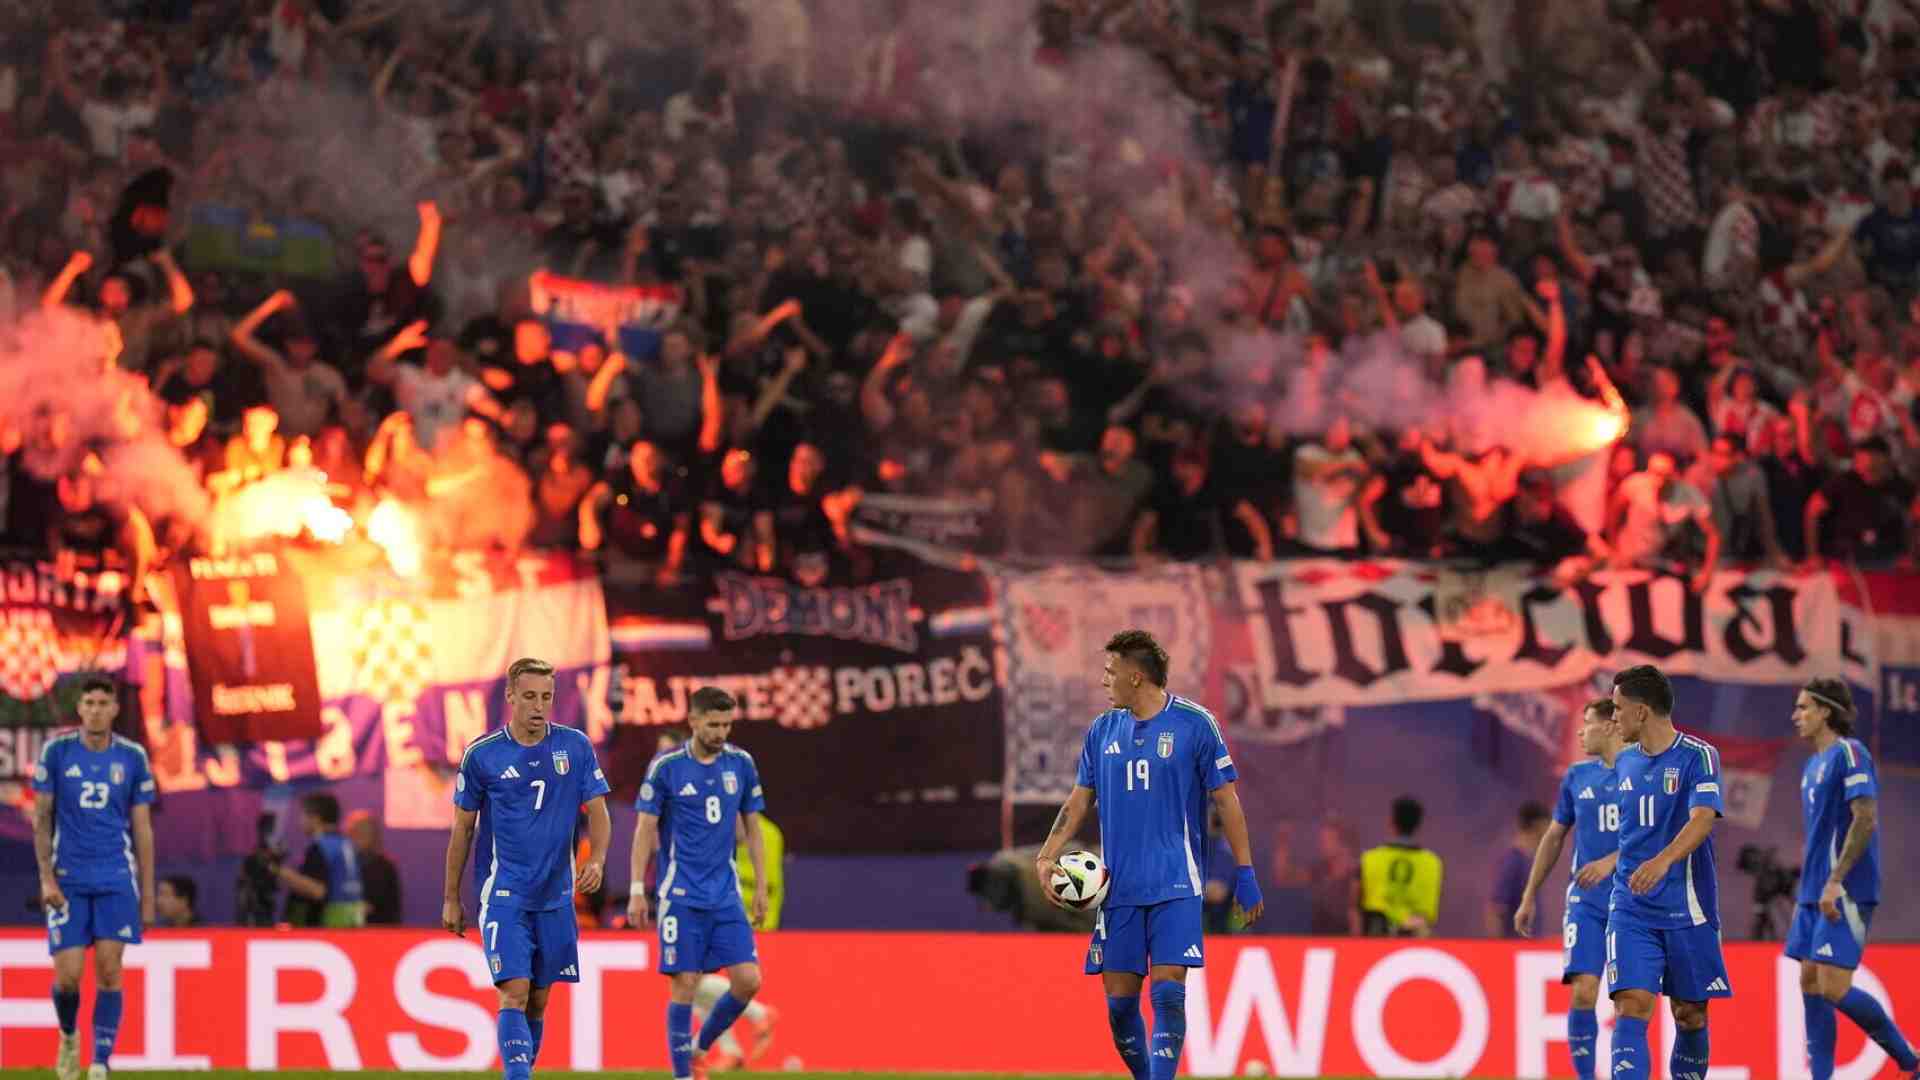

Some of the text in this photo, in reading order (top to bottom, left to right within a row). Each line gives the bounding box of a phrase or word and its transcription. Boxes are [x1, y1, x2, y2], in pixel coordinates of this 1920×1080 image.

[834, 646, 992, 714] POREČ
[1126, 759, 1150, 791] 19
[79, 782, 109, 809] 23
[530, 780, 546, 811] 7
[705, 795, 721, 825] 8
[1639, 794, 1656, 827] 11
[1599, 803, 1619, 833] 18
[485, 920, 499, 952] 7
[662, 915, 679, 944] 8
[0, 938, 649, 1072] FIRST
